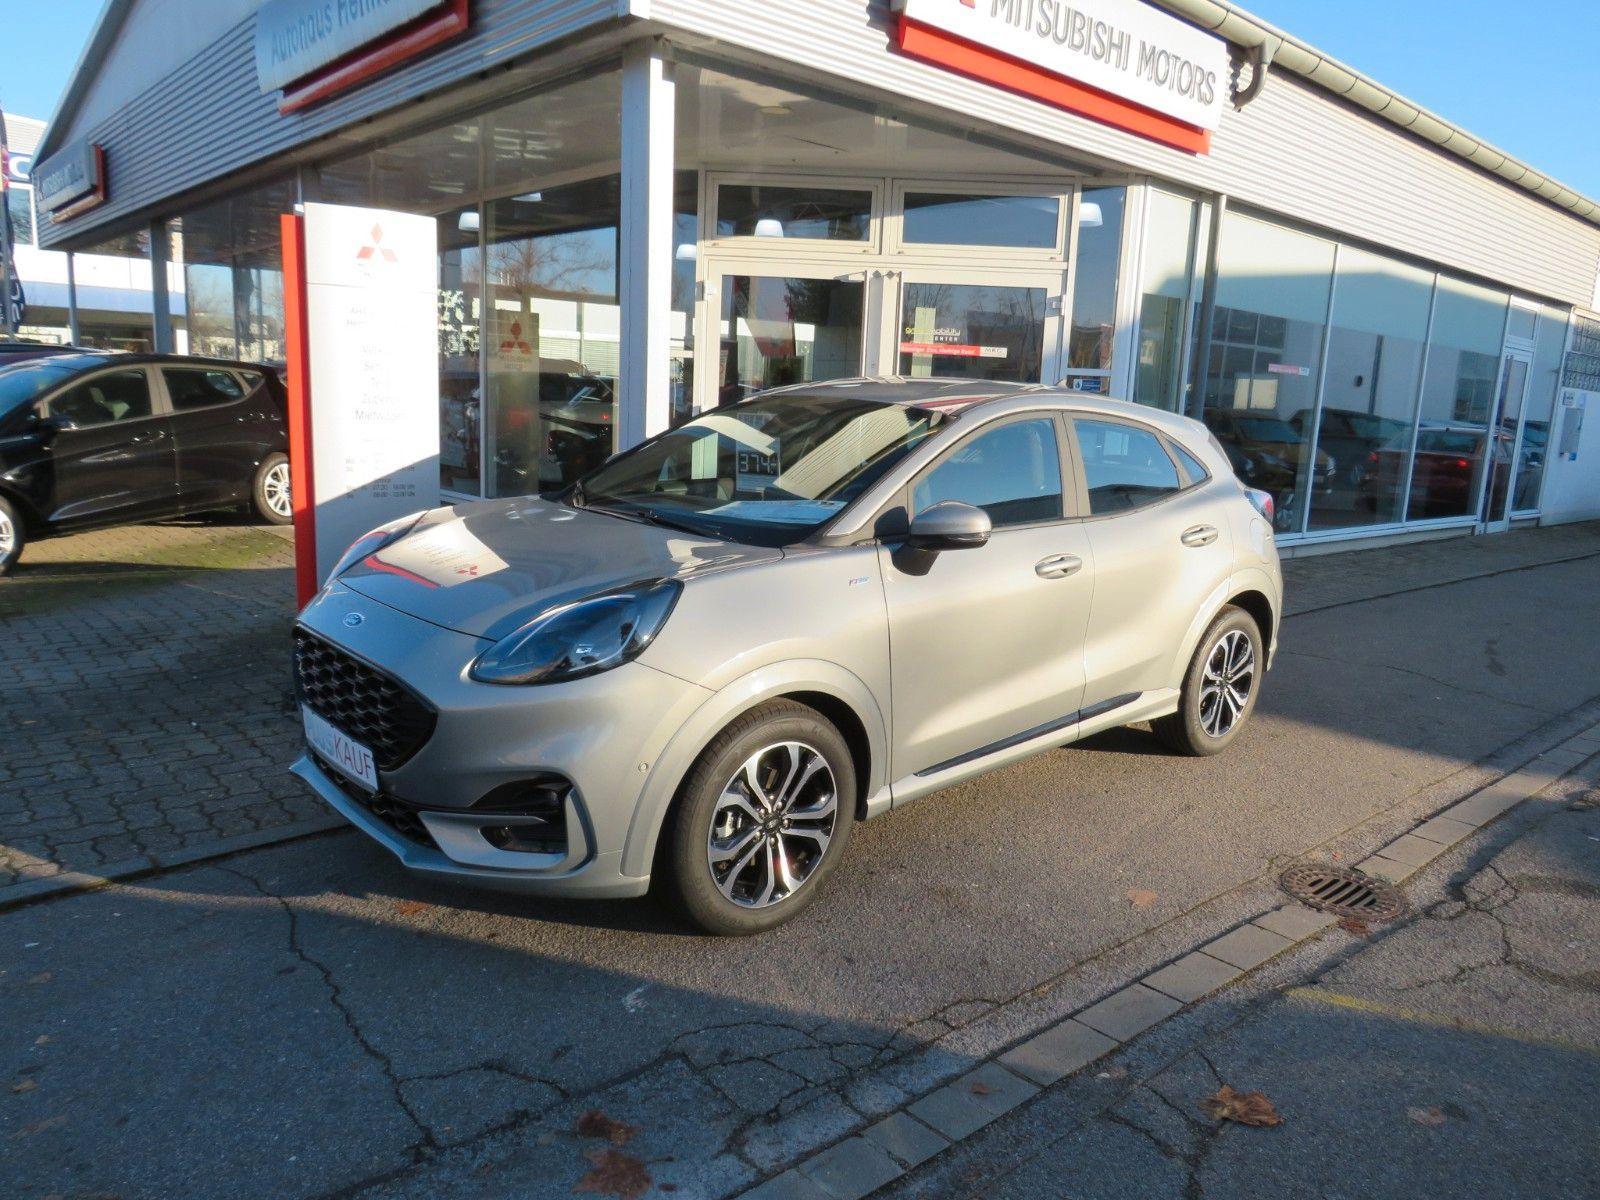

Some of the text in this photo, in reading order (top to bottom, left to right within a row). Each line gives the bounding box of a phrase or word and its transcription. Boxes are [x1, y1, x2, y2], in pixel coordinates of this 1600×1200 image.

[271, 3, 333, 66] Autohaus
[990, 0, 1216, 105] MITSUBISHI MOTORS
